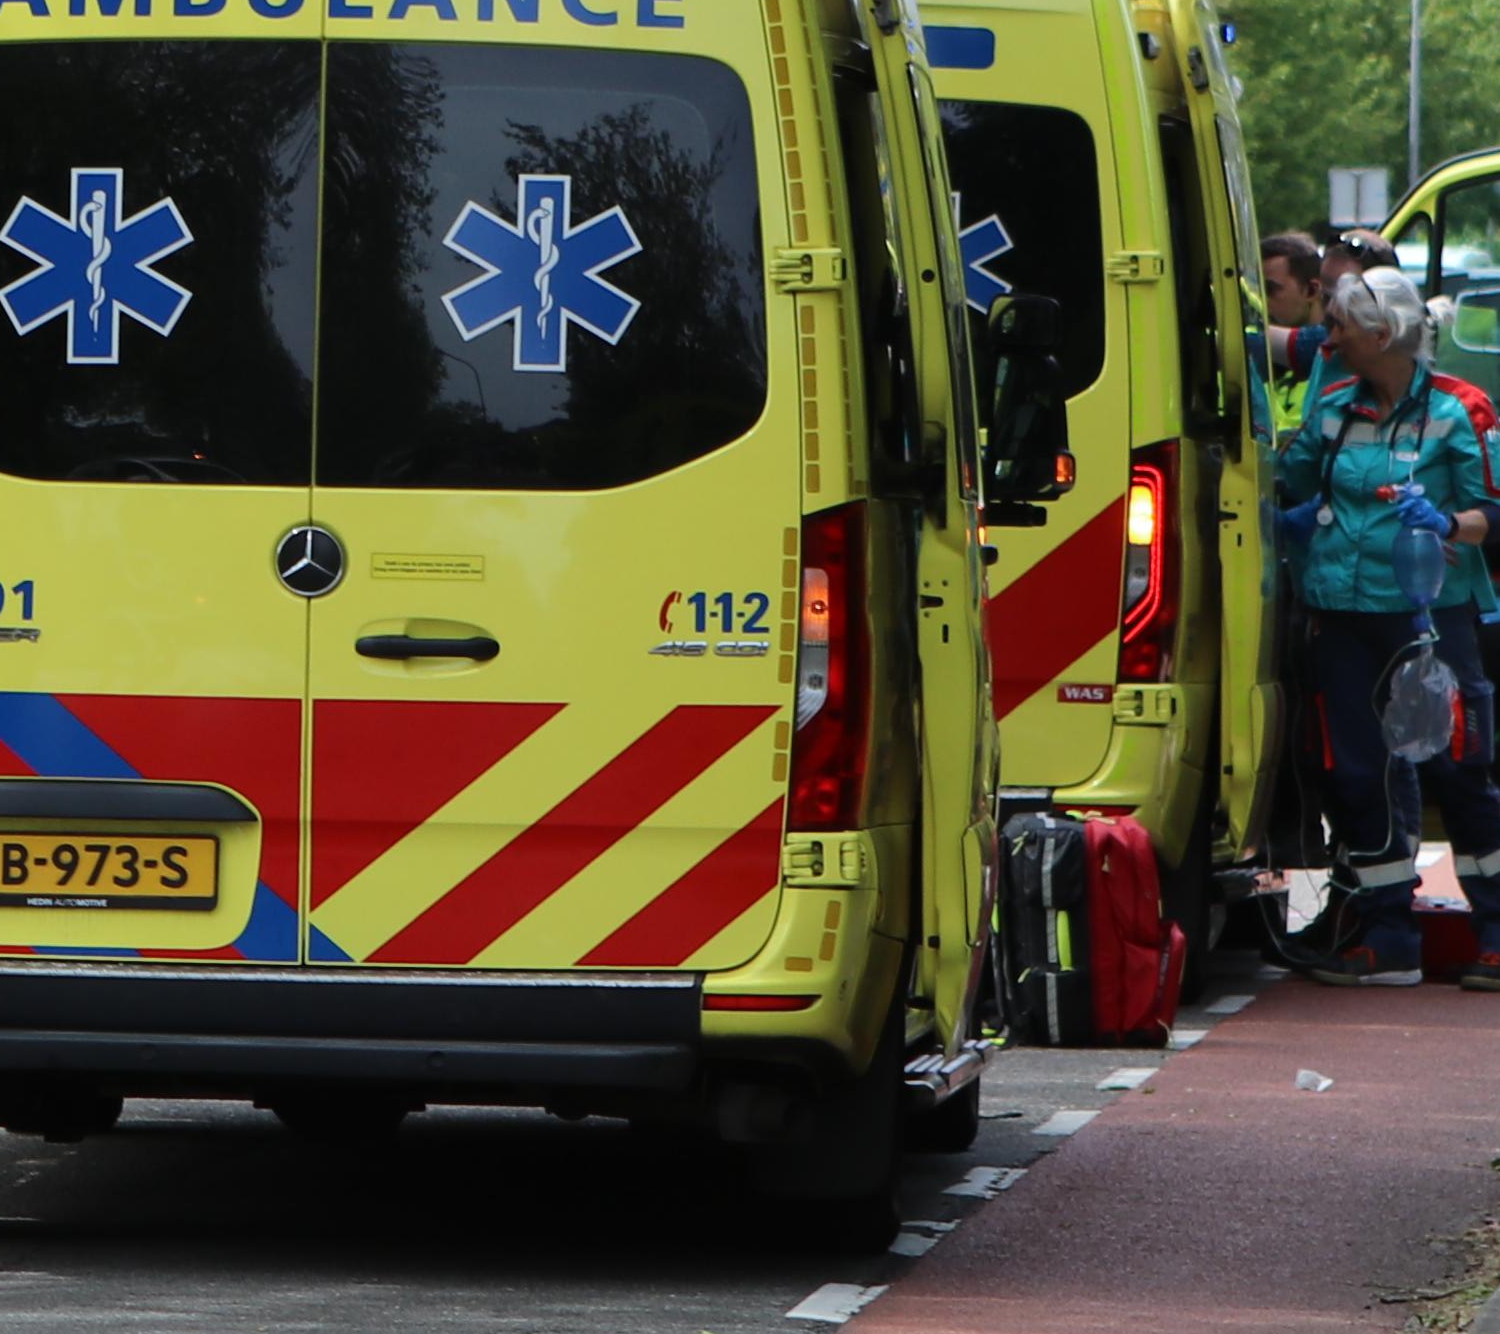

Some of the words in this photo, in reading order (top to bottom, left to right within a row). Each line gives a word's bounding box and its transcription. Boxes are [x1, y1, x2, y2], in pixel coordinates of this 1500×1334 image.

[687, 591, 770, 633] 1-1-2
[713, 640, 770, 657] CDI
[1063, 686, 1105, 700] WAS
